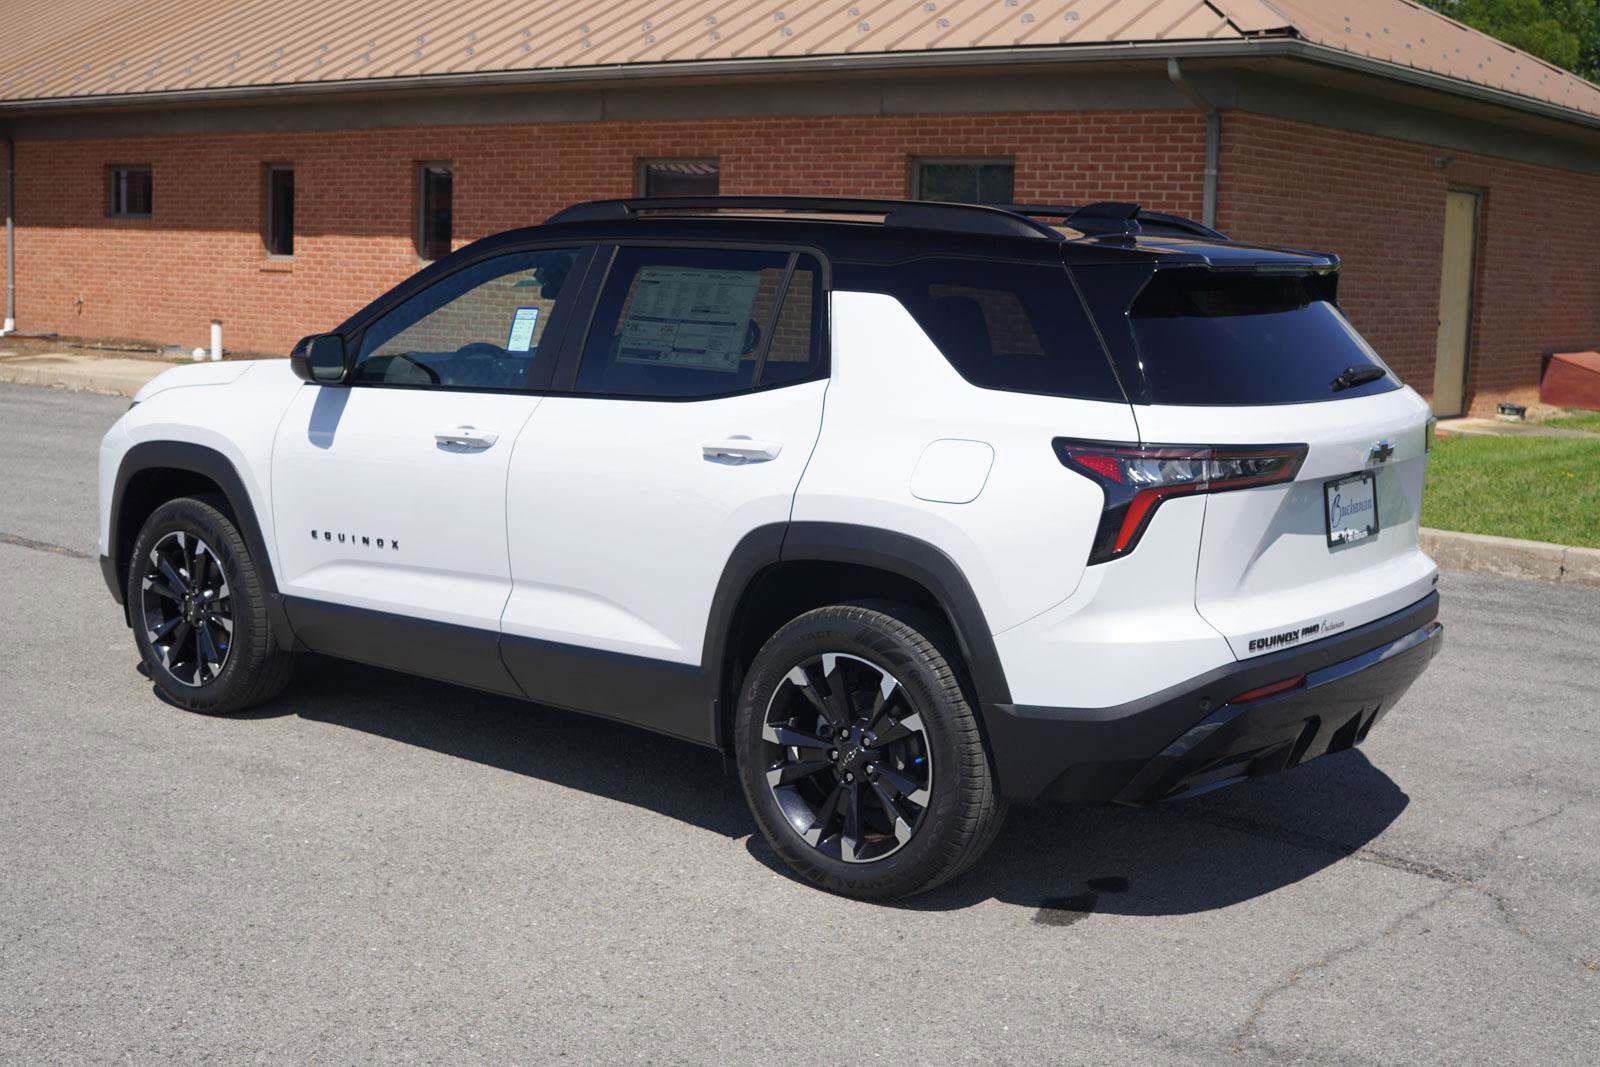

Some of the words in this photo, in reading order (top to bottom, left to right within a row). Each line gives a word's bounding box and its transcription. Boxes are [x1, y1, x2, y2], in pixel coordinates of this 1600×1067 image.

[1331, 494, 1372, 528] Buchanan
[311, 529, 399, 551] EQUINOX
[1248, 629, 1300, 651] EQUINOX
